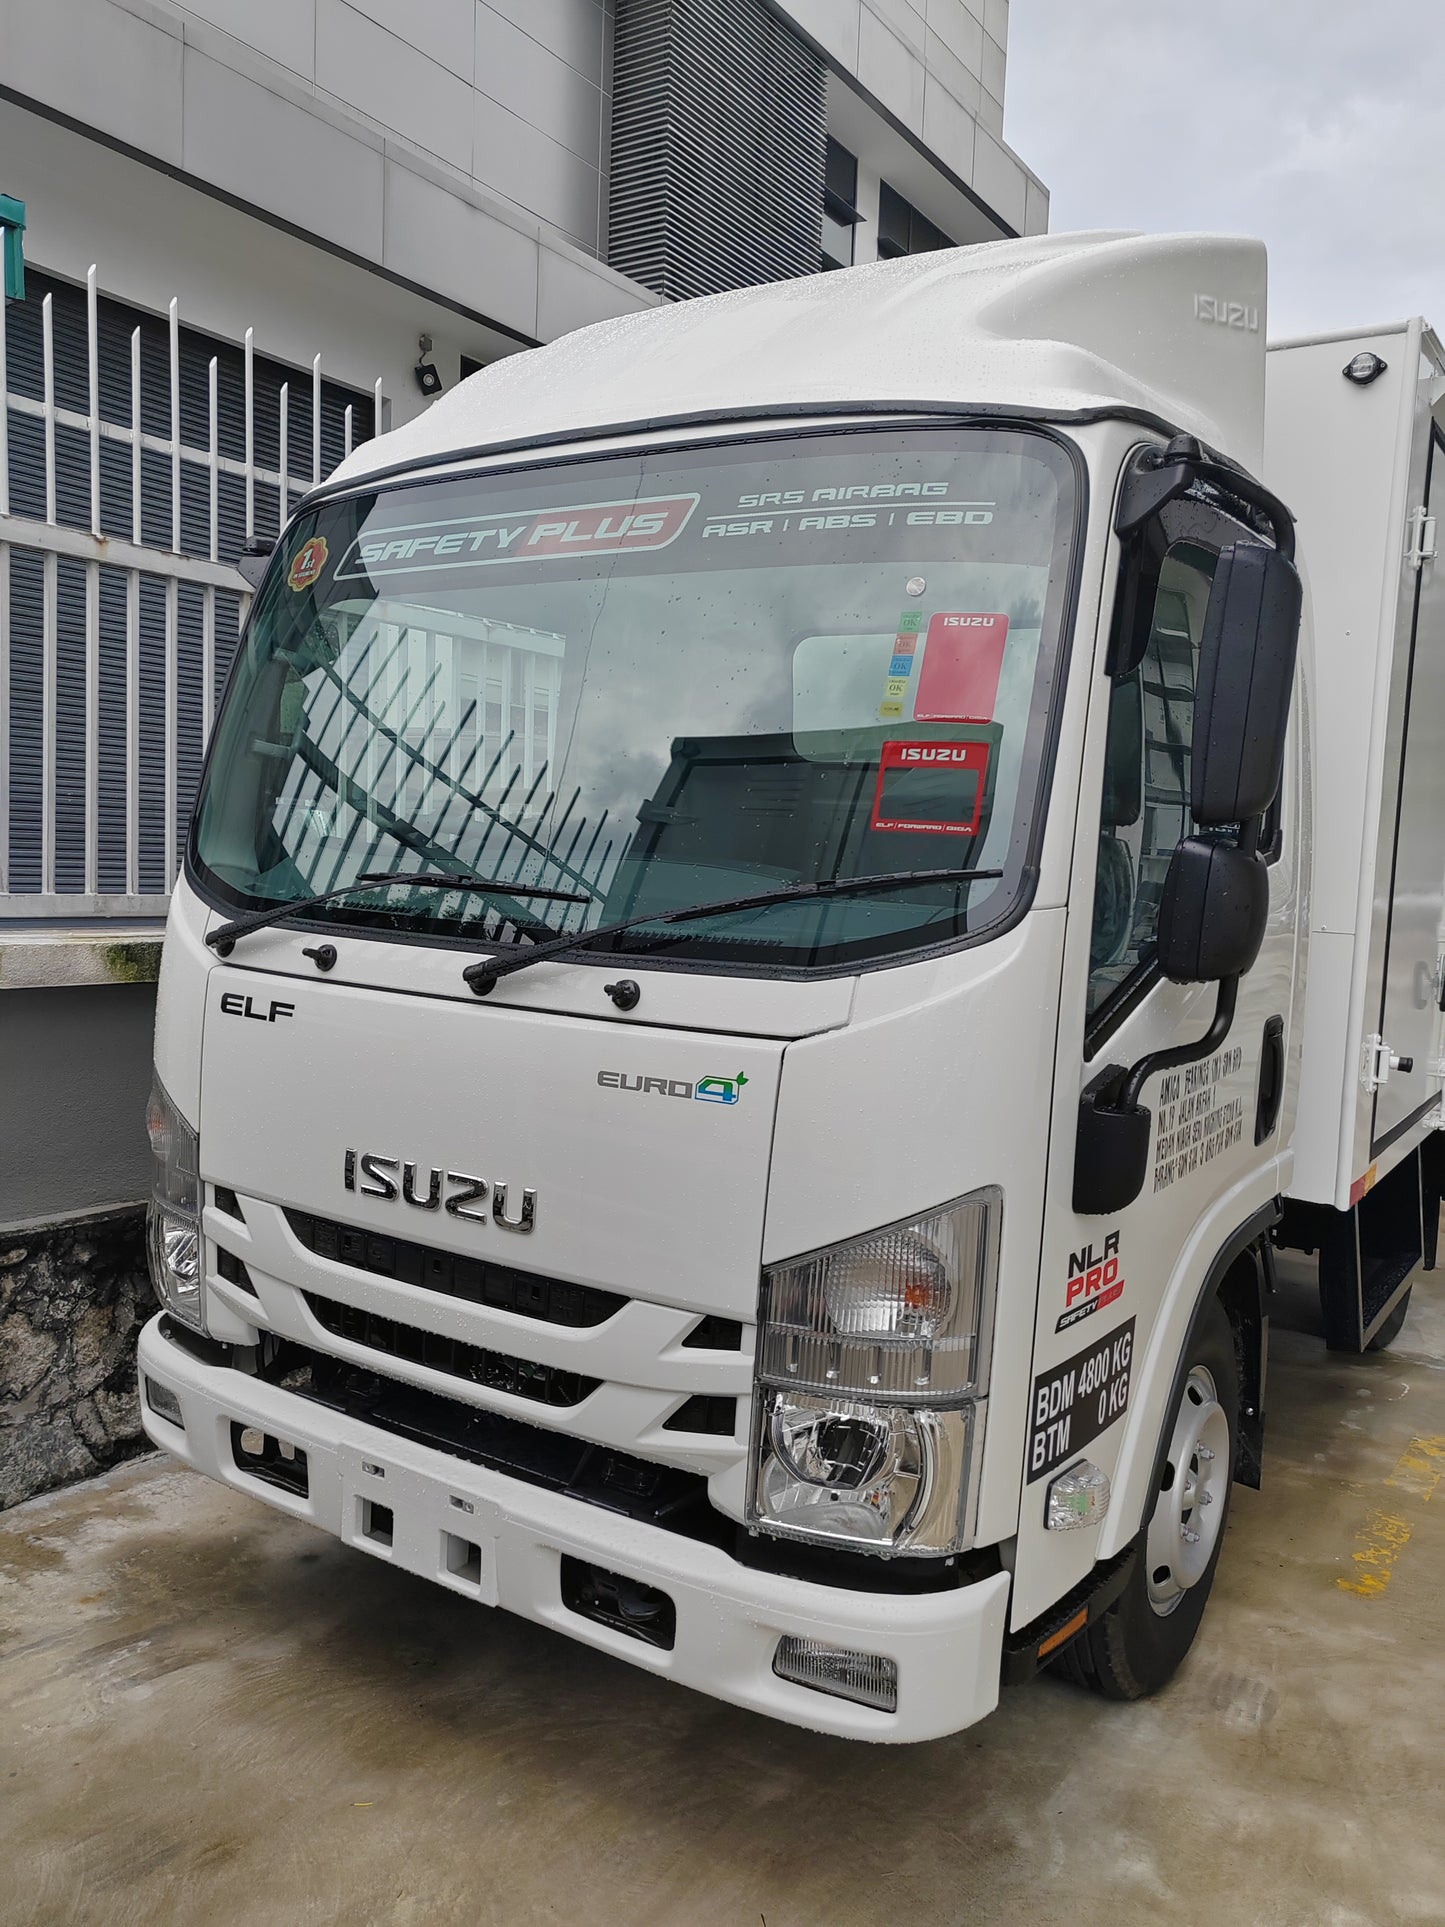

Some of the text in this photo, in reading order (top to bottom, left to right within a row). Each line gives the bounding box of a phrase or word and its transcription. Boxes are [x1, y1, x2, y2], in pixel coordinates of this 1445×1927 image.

[1194, 294, 1259, 331] ISUZU
[737, 482, 949, 508] SRS AIRBAG
[354, 512, 670, 565] SAFETY PLUS
[702, 511, 993, 538] ASR ABS EBD
[943, 617, 995, 627] ISUZU
[889, 684, 903, 692] OK
[901, 748, 966, 762] ISUZU
[220, 993, 295, 1022] ELF
[1178, 1095, 1195, 1126] JALAN
[344, 1147, 538, 1235] ISUZU
[1068, 1230, 1120, 1279] NLR
[1066, 1257, 1118, 1308] PRO
[1060, 1299, 1098, 1328] SAFETY
[1036, 1331, 1132, 1427] BDM 4800 KG
[1031, 1372, 1129, 1472] BTM 0 KG
